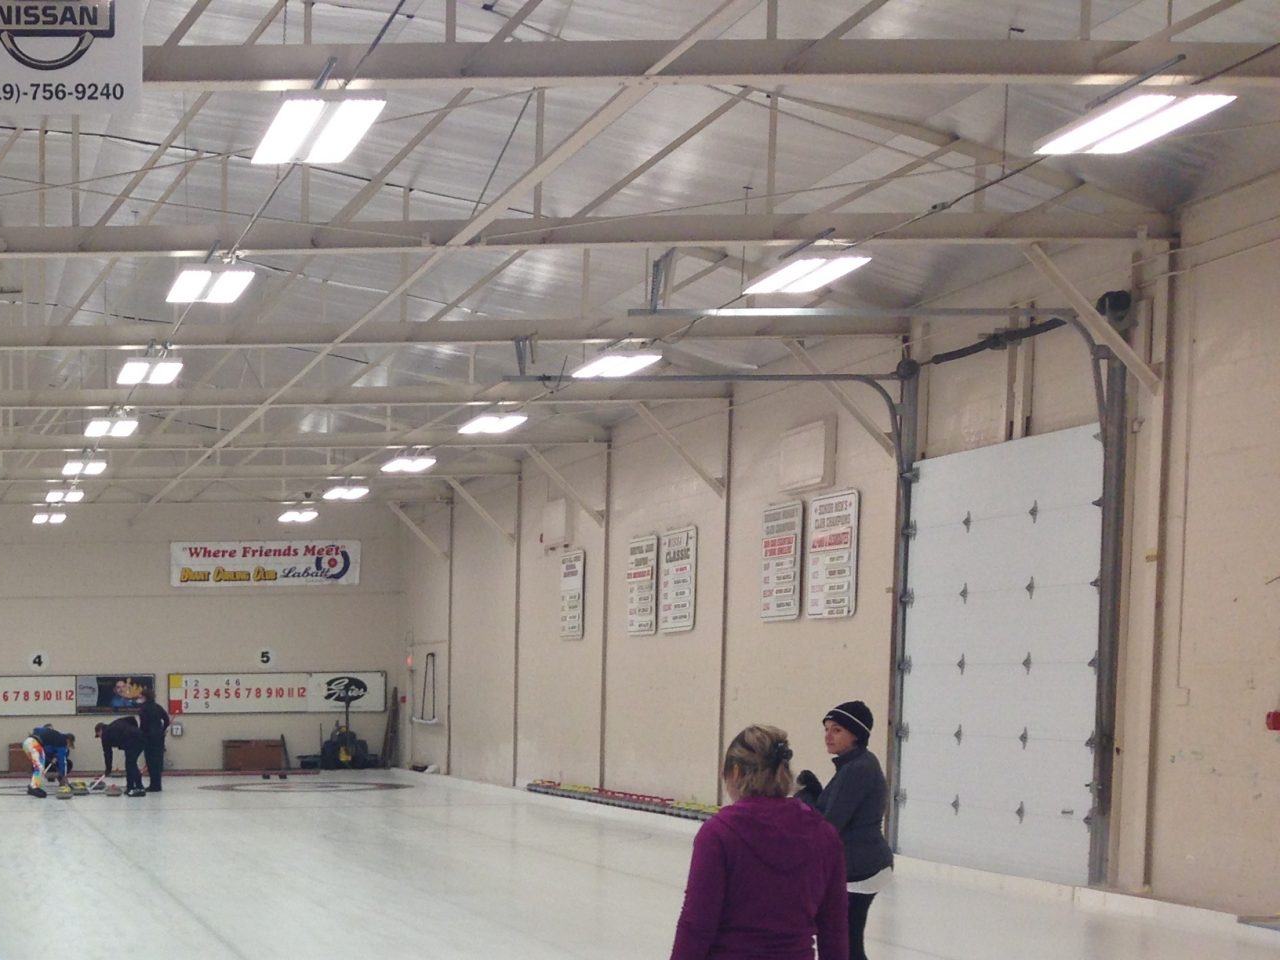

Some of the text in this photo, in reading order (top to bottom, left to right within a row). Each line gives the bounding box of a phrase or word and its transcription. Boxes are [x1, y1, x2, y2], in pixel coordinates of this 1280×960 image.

[241, 546, 299, 557] Friends
[32, 655, 43, 667] 4
[261, 652, 270, 663] 5
[2, 692, 9, 701] 6
[13, 691, 20, 701] 7
[23, 691, 29, 701] 8
[34, 691, 40, 701] 9
[43, 691, 52, 700] 10
[56, 691, 62, 700] 11
[65, 690, 74, 700] 12
[184, 688, 306, 699] 1 2 3 4 5 6 7 8 9 10 11 12
